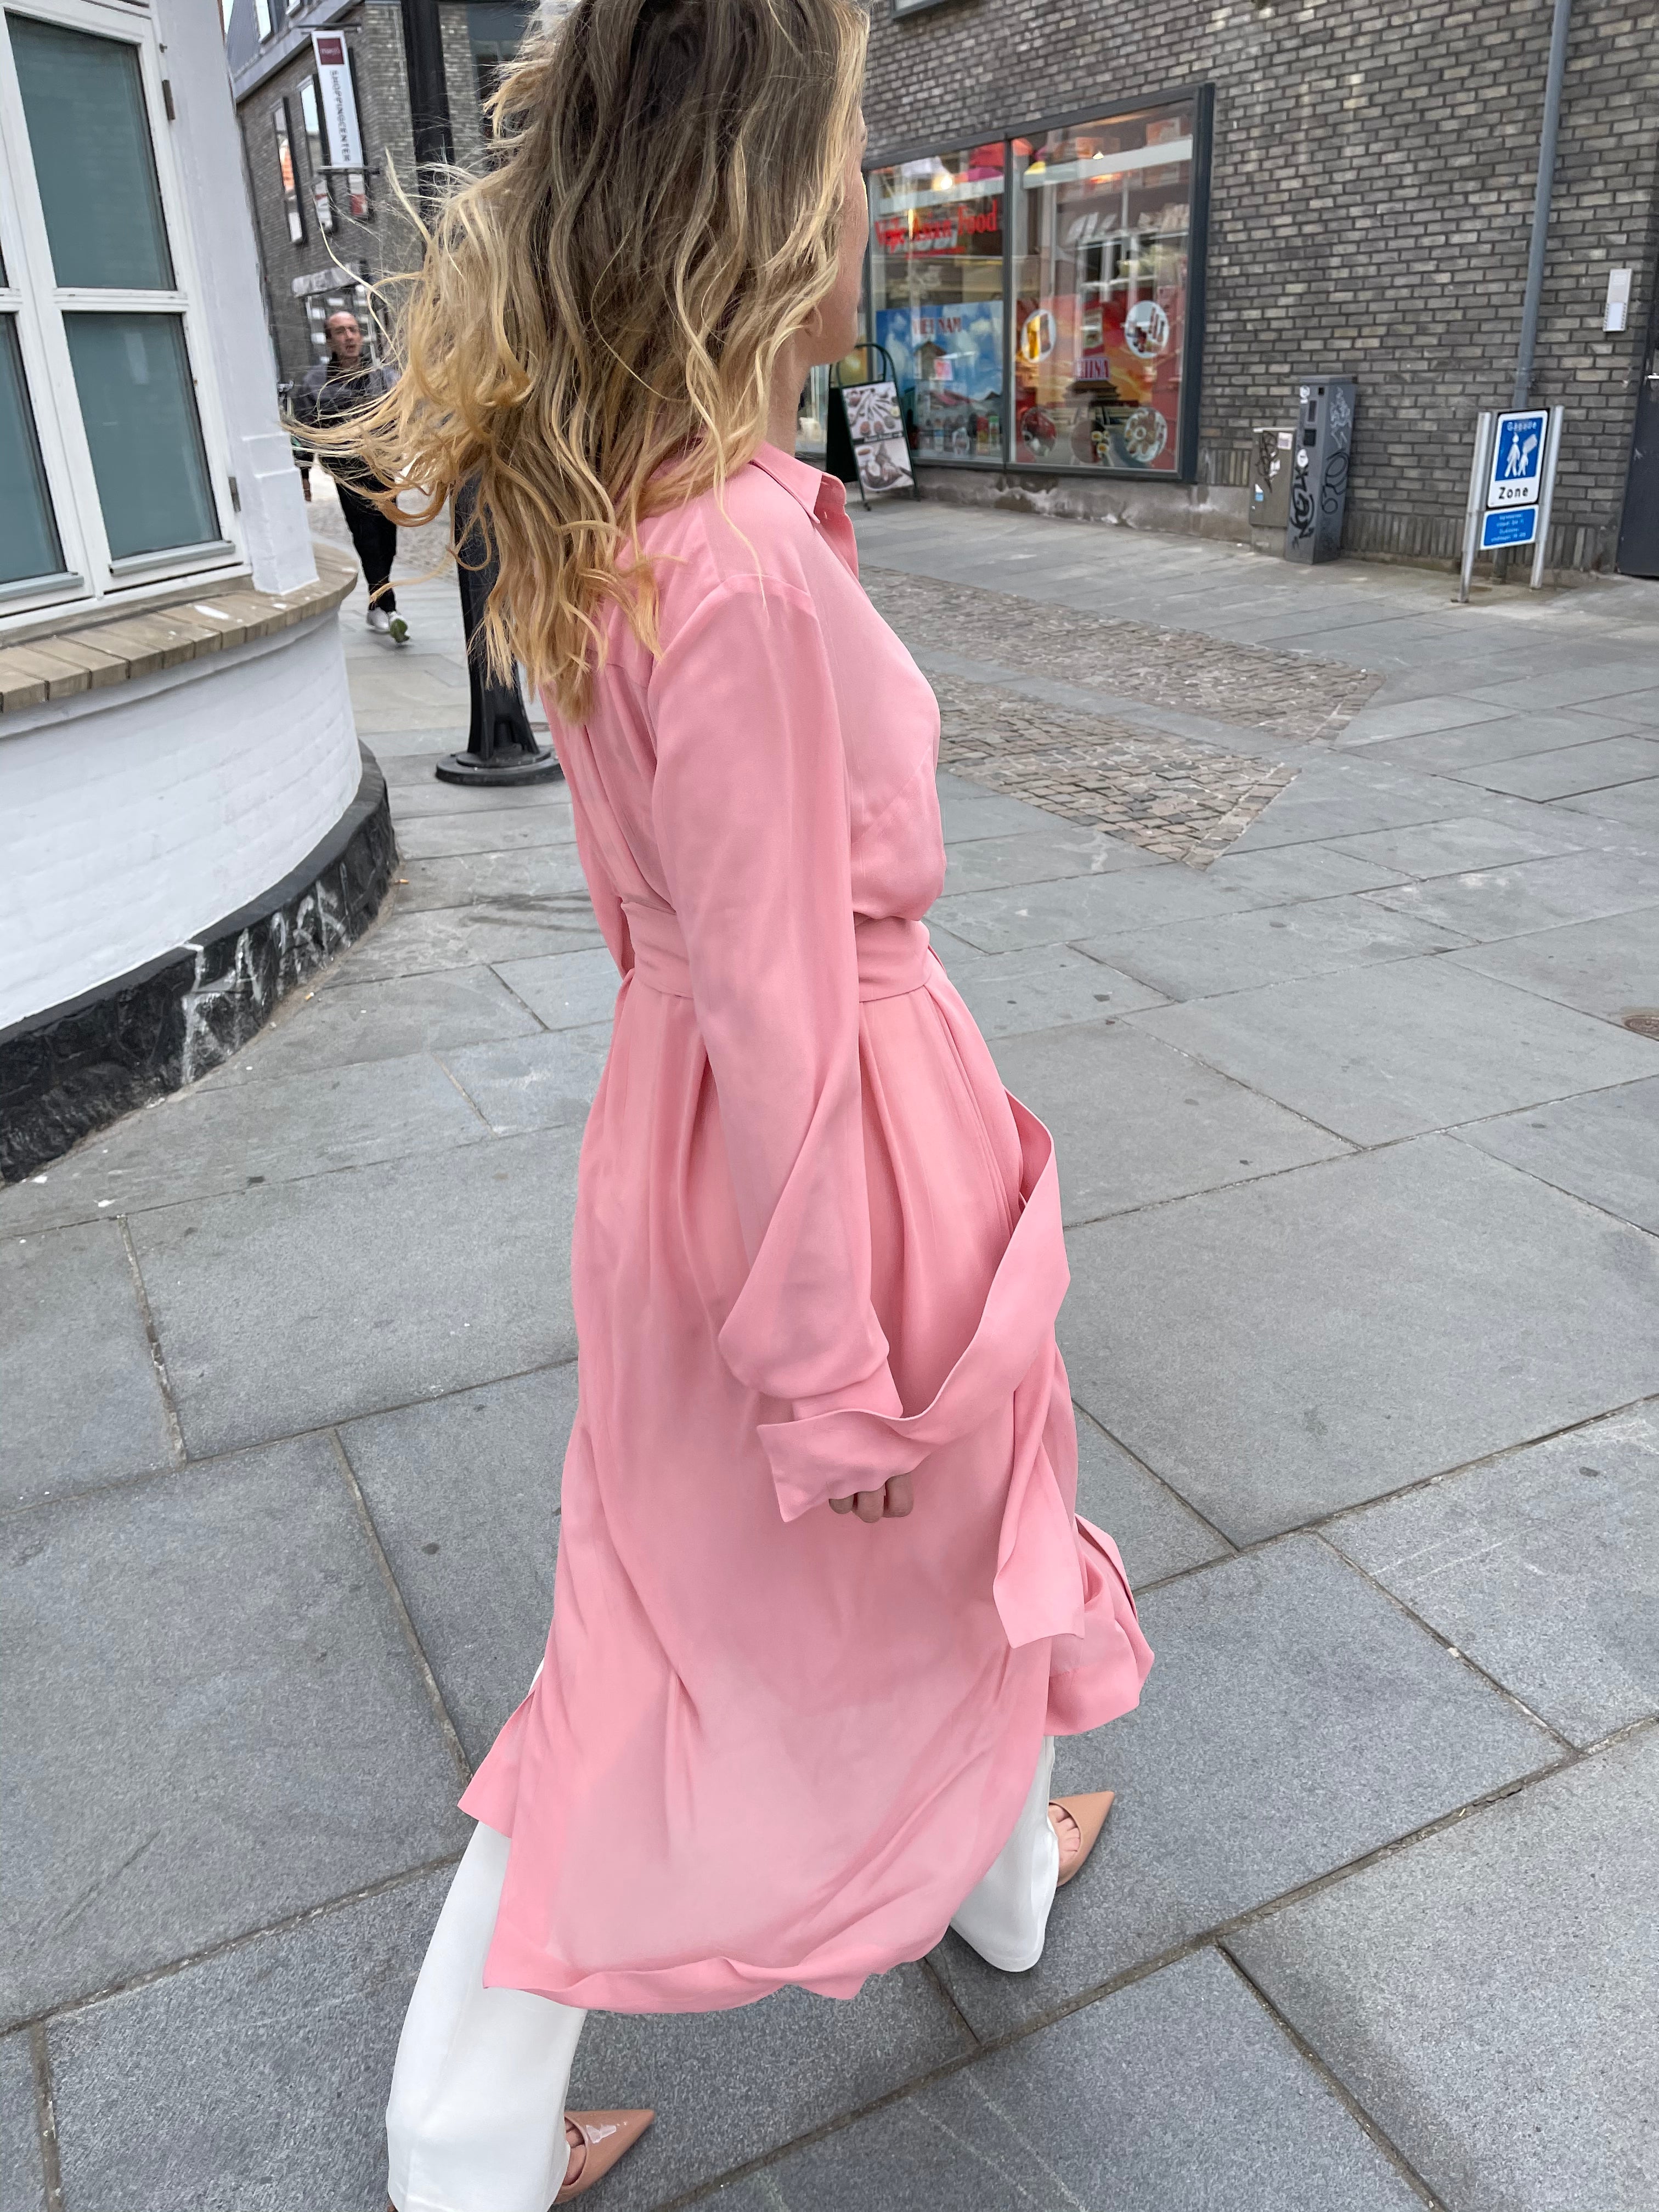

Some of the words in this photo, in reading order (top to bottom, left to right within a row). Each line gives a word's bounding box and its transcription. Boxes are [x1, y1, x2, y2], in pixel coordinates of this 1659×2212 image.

[330, 70, 351, 162] SHOPPINGCENTER
[957, 199, 997, 236] Food
[938, 317, 962, 333] NAM
[1499, 486, 1529, 500] Zone
